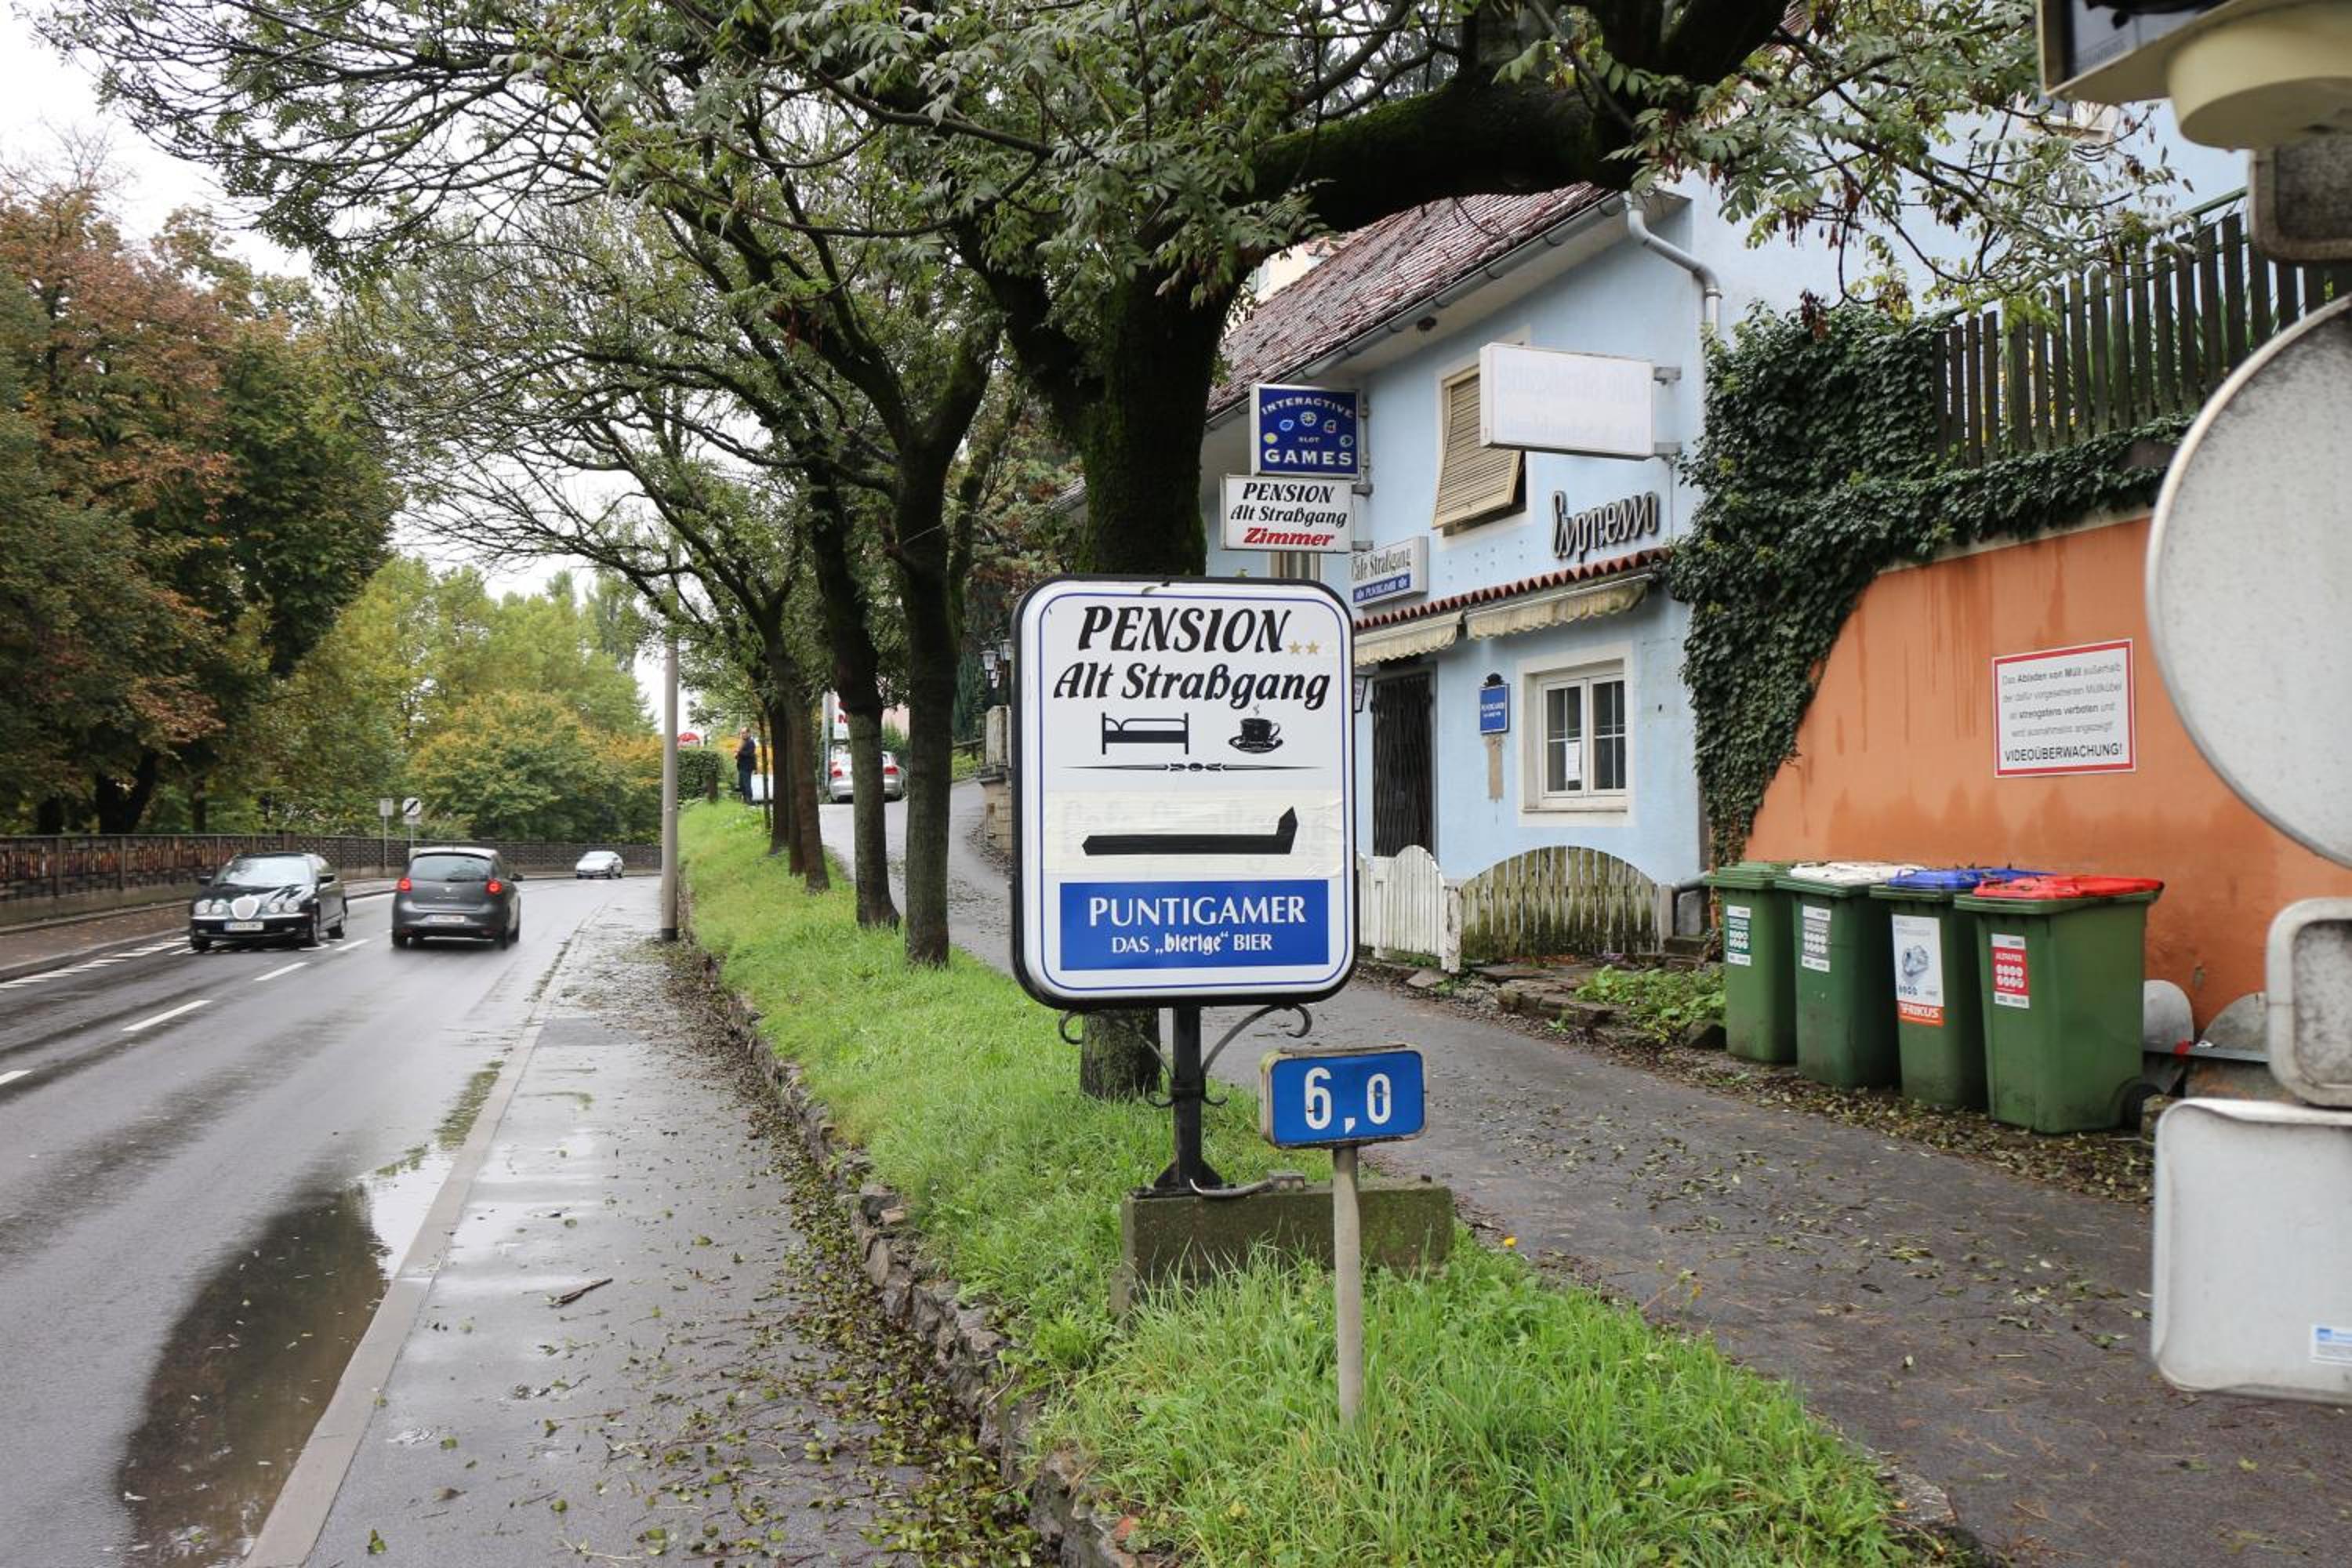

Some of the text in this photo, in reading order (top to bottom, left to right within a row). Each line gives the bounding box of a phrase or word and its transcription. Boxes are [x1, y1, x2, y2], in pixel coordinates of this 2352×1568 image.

[1261, 397, 1355, 419] INTERACTIVE
[1265, 448, 1352, 466] GAMES
[1242, 482, 1335, 504] PENSION
[1230, 504, 1348, 528] Alt Straßgang
[1243, 527, 1335, 546] Zimmer
[1077, 605, 1292, 654] PENSION
[1053, 661, 1115, 699] Alt
[1121, 662, 1331, 711] Straßgang
[2017, 672, 2047, 684] Abladen
[2049, 670, 2063, 680] von
[2063, 703, 2099, 715] verboten
[2005, 742, 2123, 762] VIDEOÜBERWACHUNG!
[1089, 896, 1307, 927] PUNTIGAMER
[1112, 936, 1150, 954] DAS
[1233, 934, 1273, 952] BIER
[1304, 1066, 1392, 1134] 6,0
